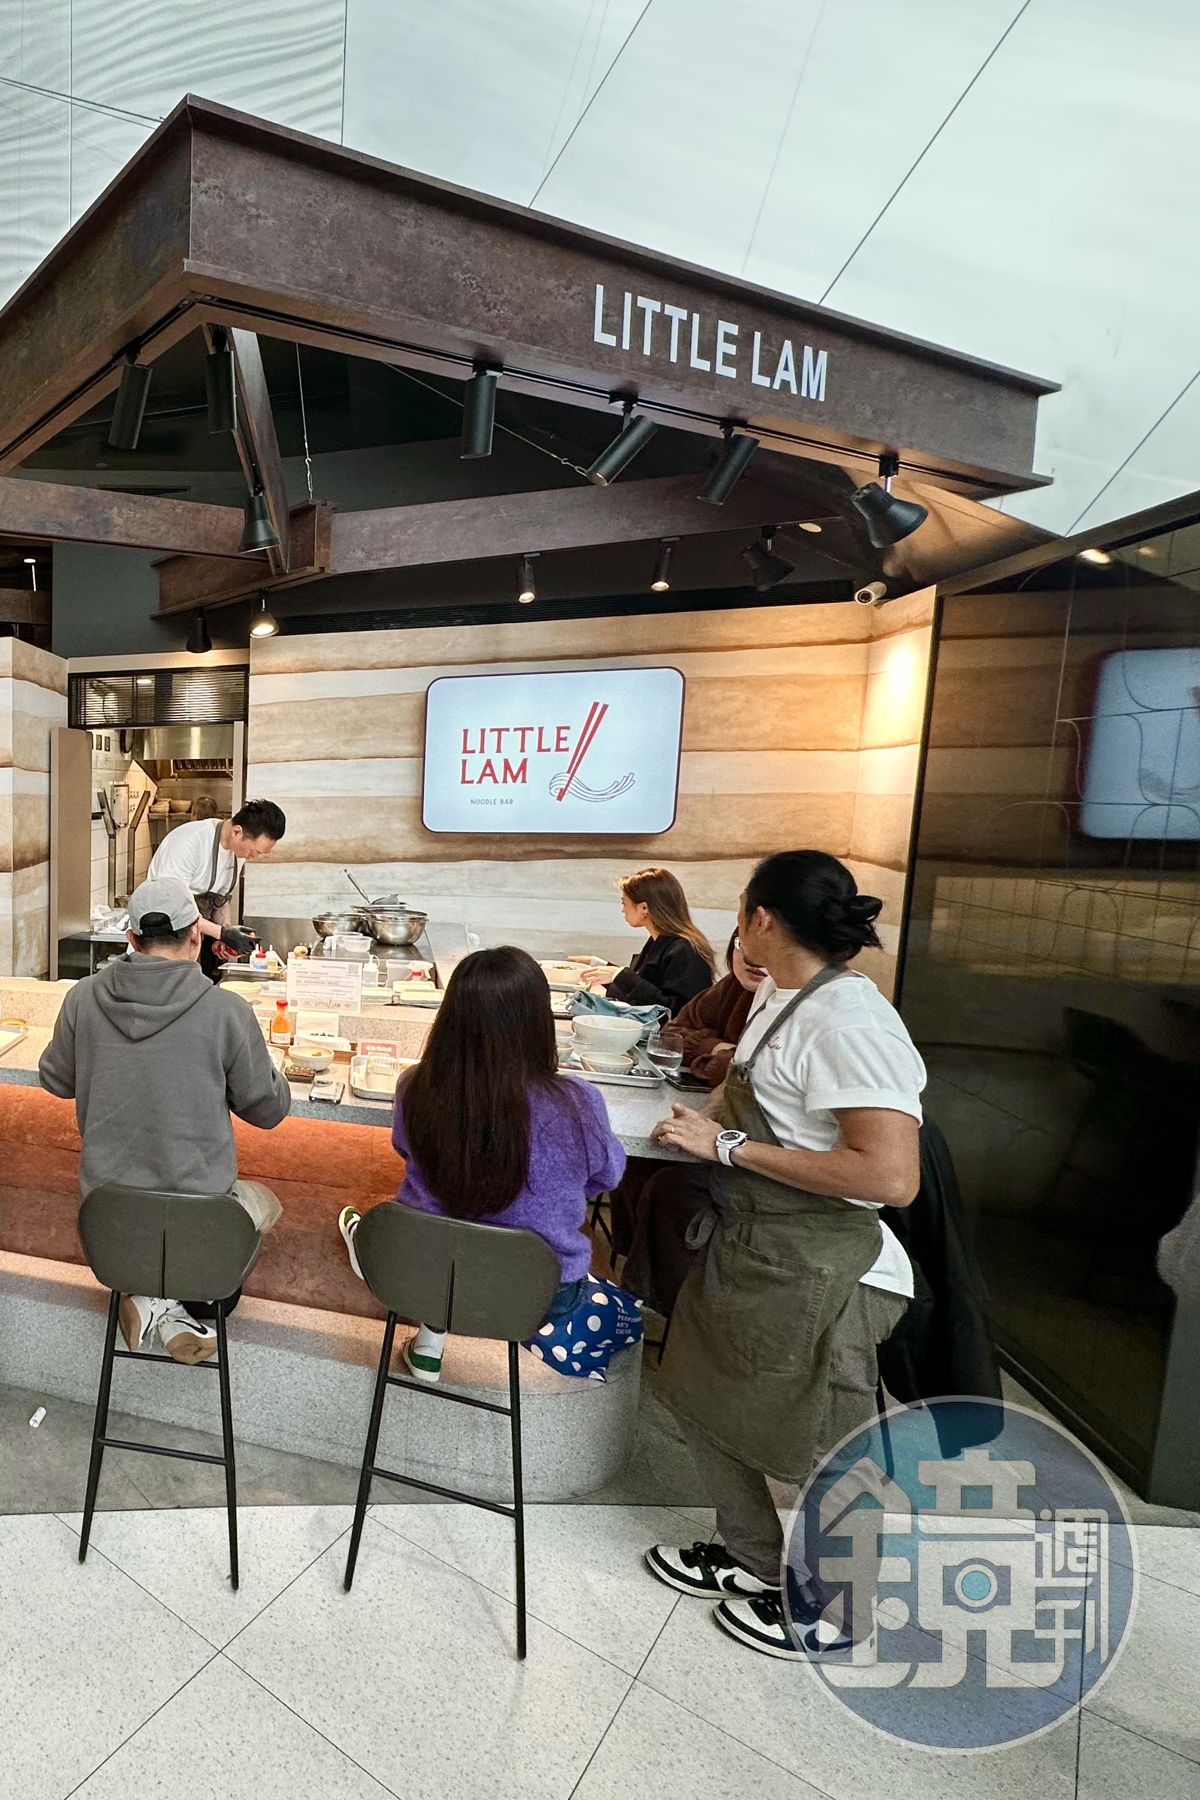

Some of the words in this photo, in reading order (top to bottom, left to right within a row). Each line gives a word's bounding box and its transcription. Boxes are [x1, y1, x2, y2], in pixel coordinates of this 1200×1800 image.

[593, 283, 739, 379] LITTLE
[751, 330, 828, 402] LAM
[461, 725, 571, 754] LITTLE
[460, 758, 528, 784] LAM
[470, 798, 497, 806] NOODLE
